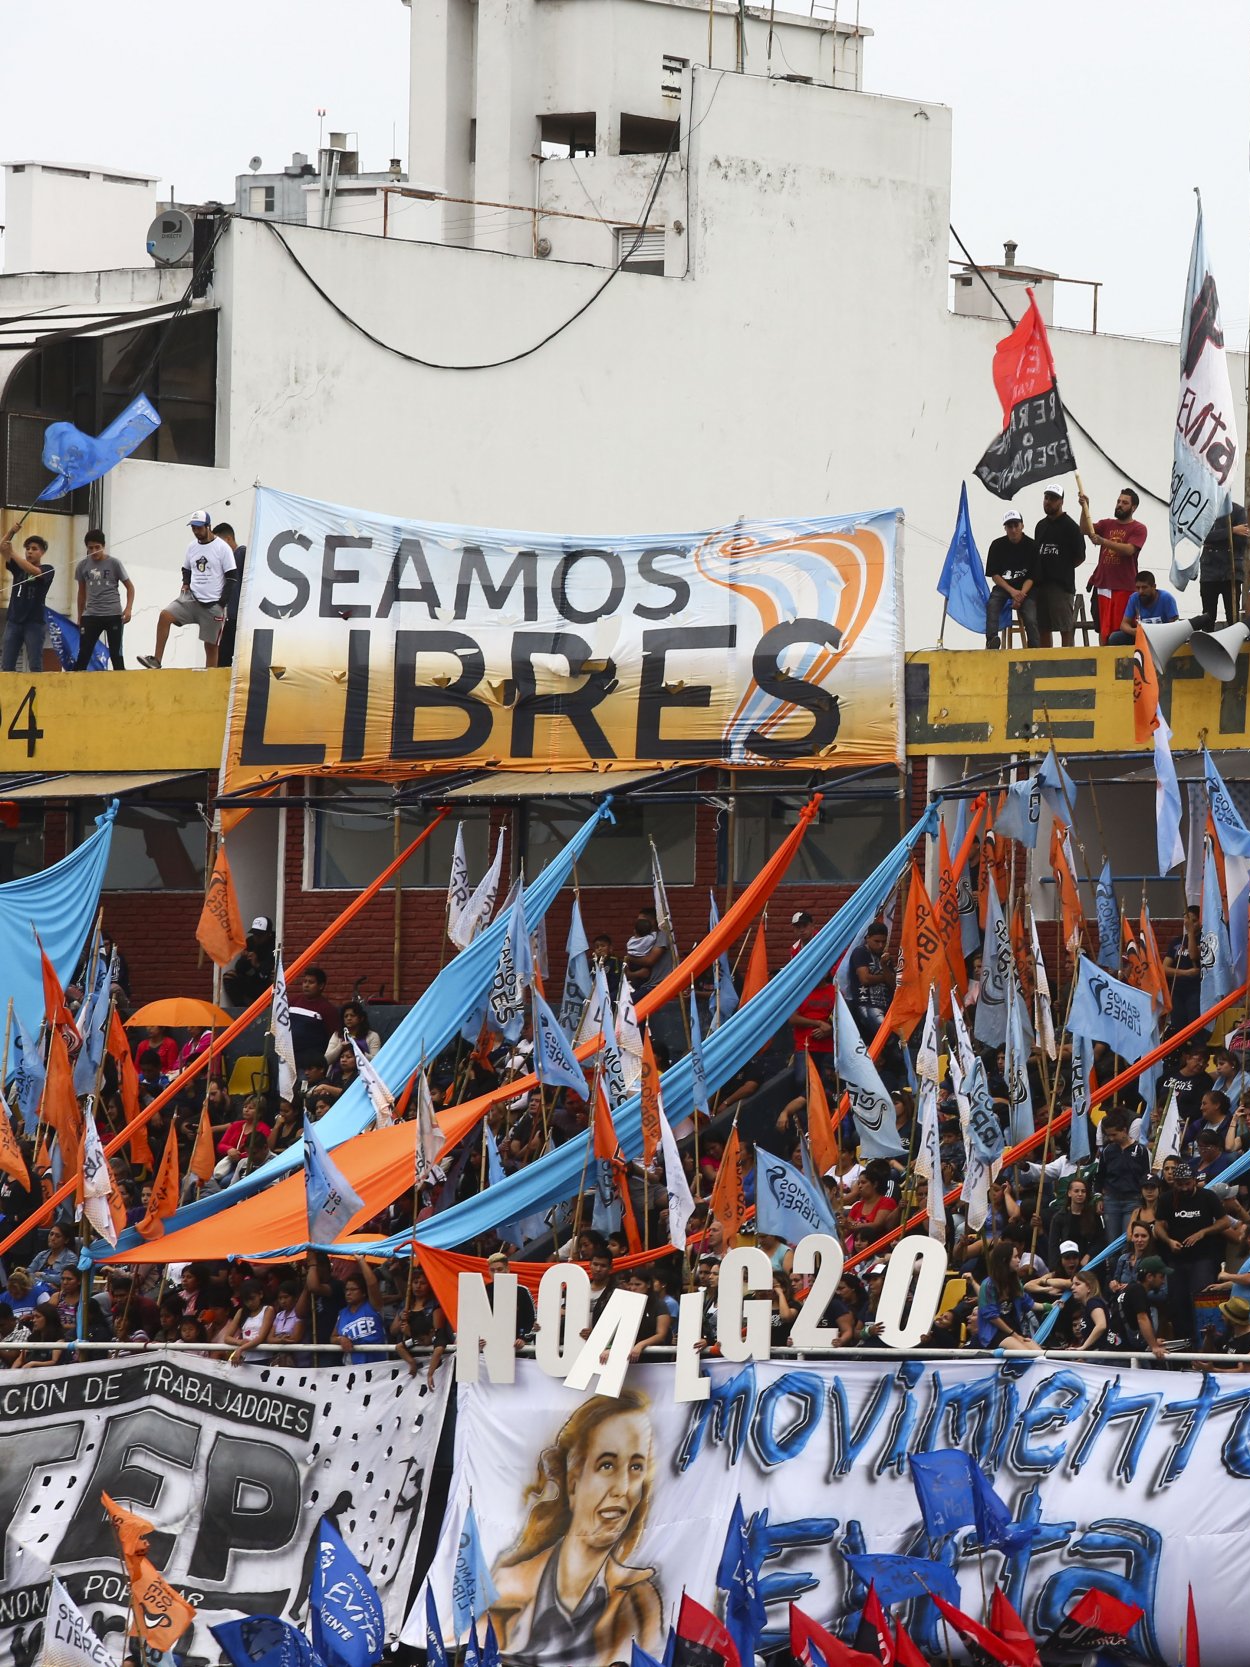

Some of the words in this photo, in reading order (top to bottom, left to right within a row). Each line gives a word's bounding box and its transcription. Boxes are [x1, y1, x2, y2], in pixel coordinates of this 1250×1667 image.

[257, 528, 694, 625] SEAMOS
[6, 686, 46, 759] 4
[239, 616, 842, 767] LIBRES
[455, 1263, 592, 1384] NO
[717, 1233, 948, 1362] G20
[84, 1373, 123, 1403] DE
[143, 1366, 310, 1433] TRABAJADORES
[58, 1603, 93, 1634] SEA
